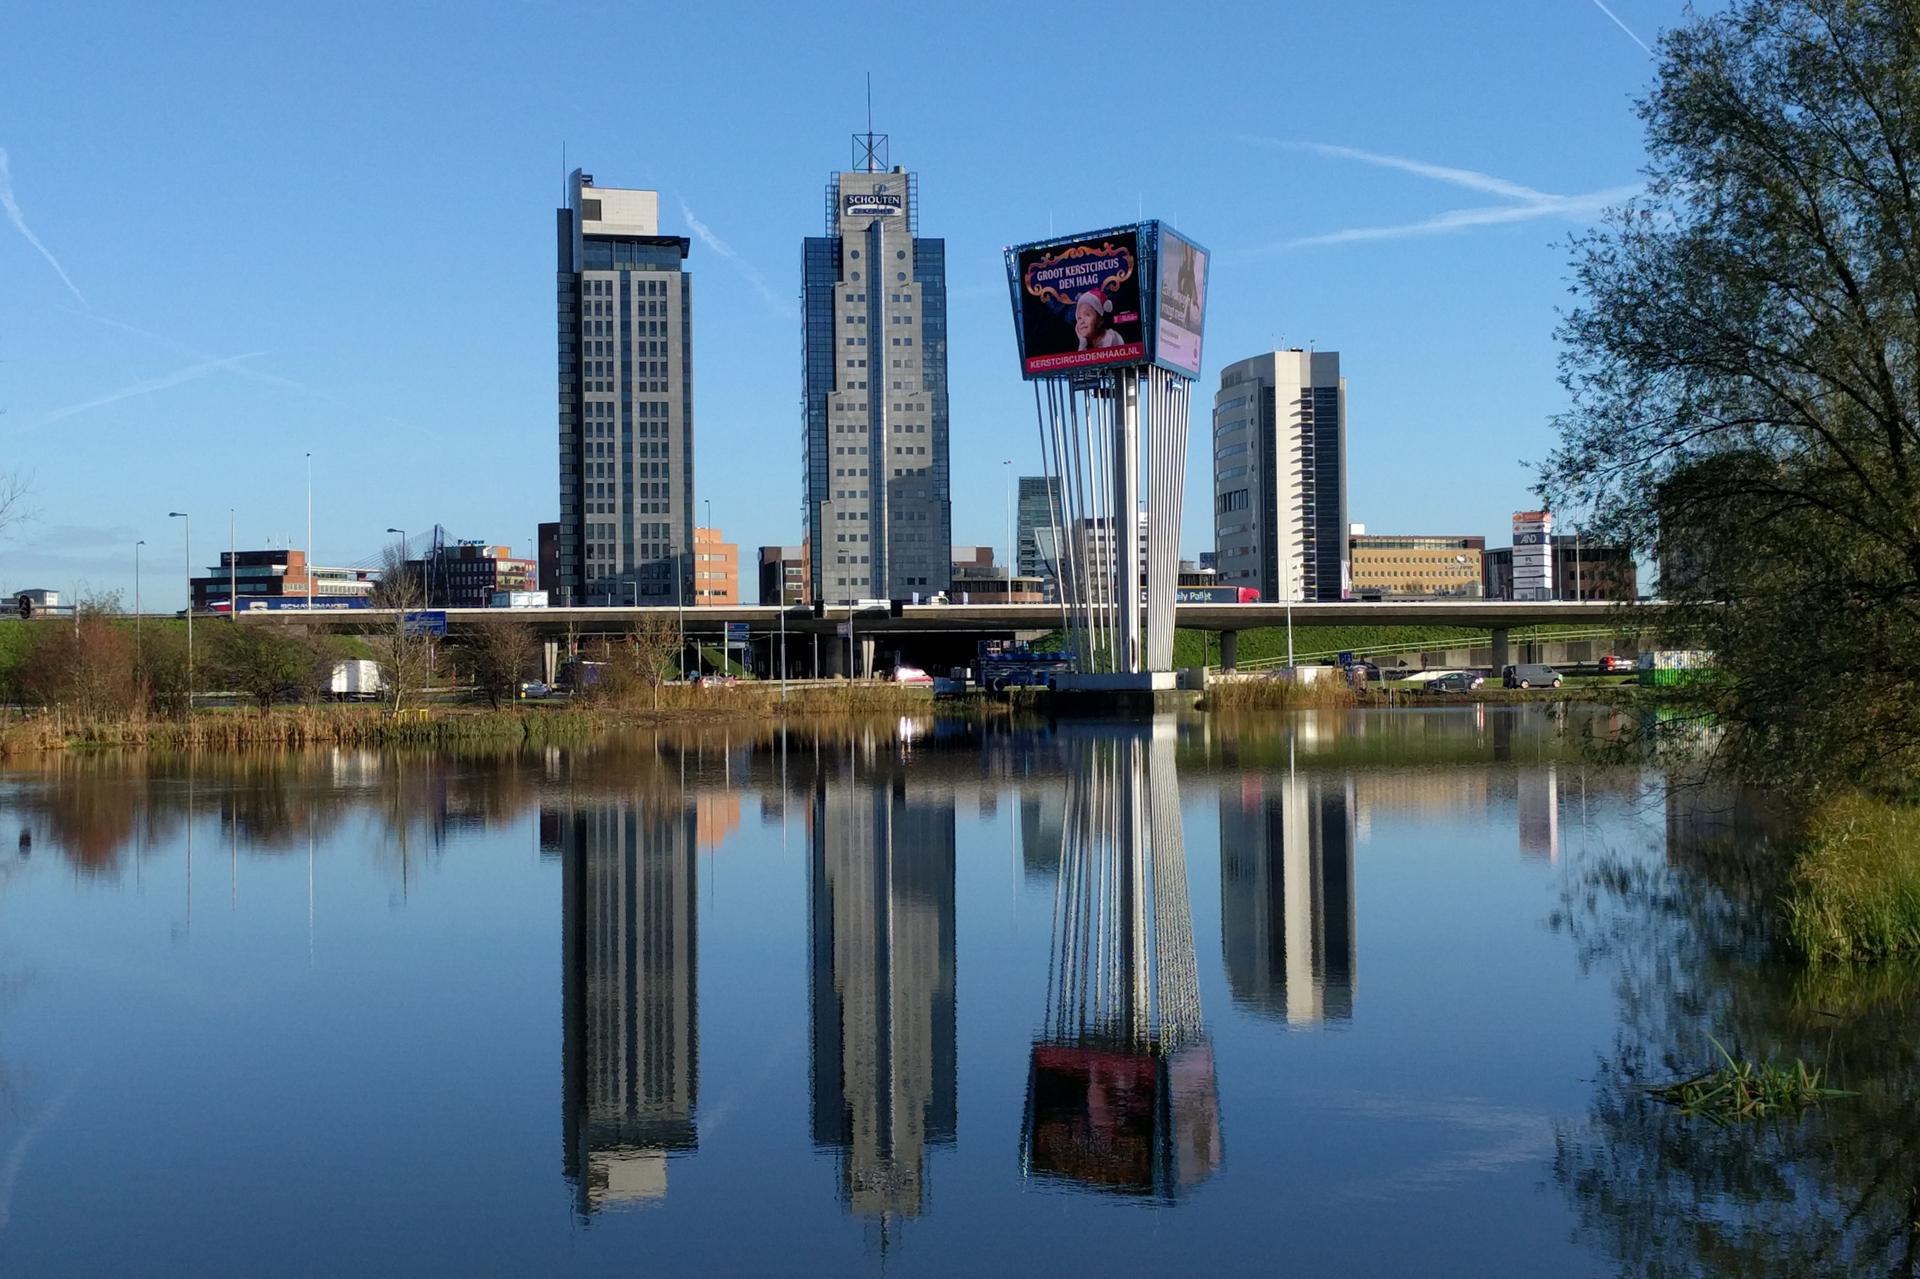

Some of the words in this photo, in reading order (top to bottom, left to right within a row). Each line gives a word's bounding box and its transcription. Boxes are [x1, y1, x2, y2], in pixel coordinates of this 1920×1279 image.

[849, 195, 900, 204] SCHOUTEN
[1037, 268, 1064, 282] GROOT
[1065, 258, 1119, 277] KERSTCIRCUS
[1058, 277, 1075, 290] DEN
[1076, 273, 1099, 287] HAAG
[1030, 347, 1140, 368] KERSTCIRCUSDENHAAG.NL
